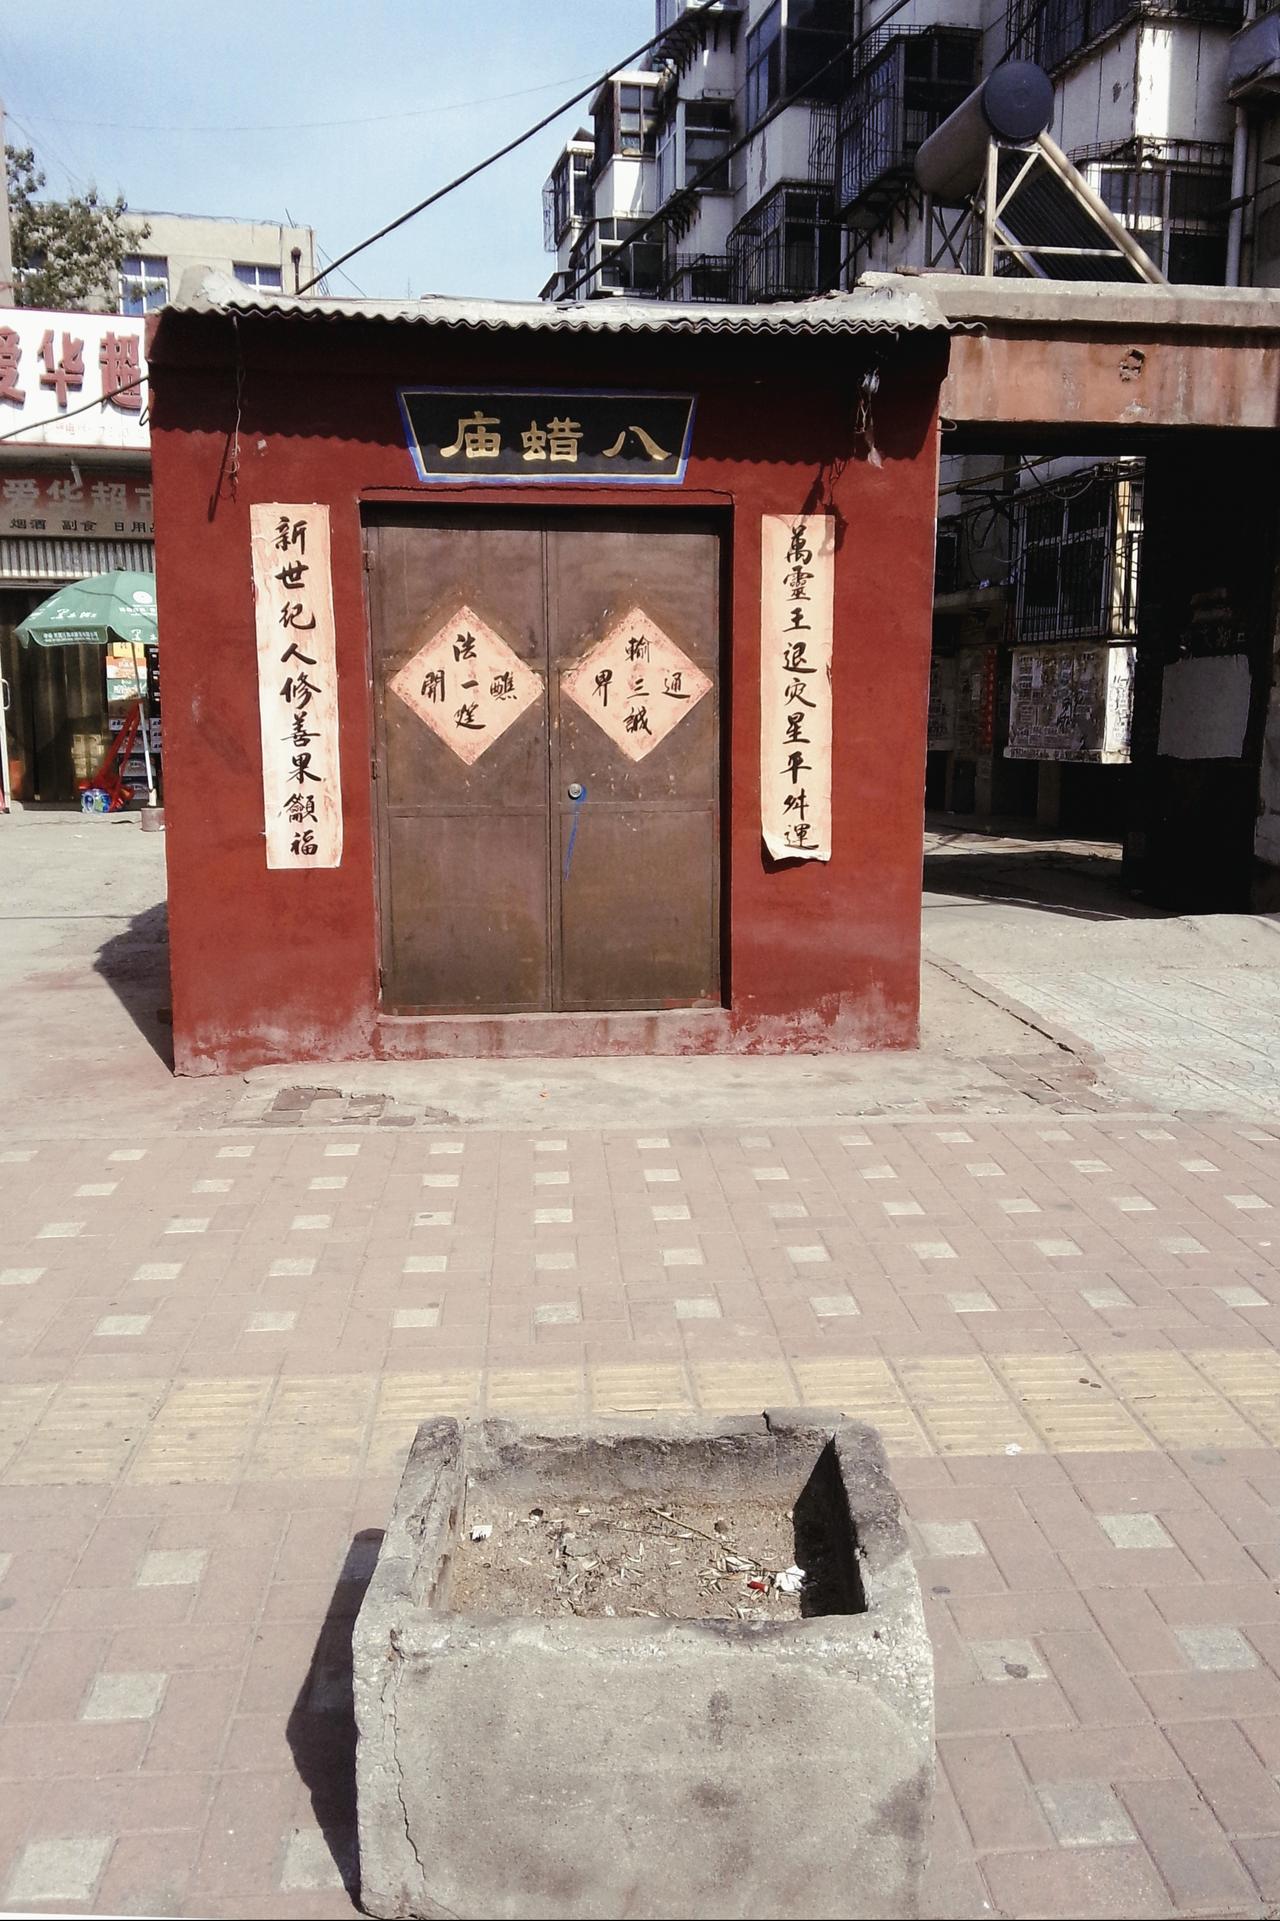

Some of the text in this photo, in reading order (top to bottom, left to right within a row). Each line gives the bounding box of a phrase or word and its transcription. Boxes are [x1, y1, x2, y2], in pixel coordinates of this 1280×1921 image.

[10, 518, 154, 532] 烟酒 副食 日用
